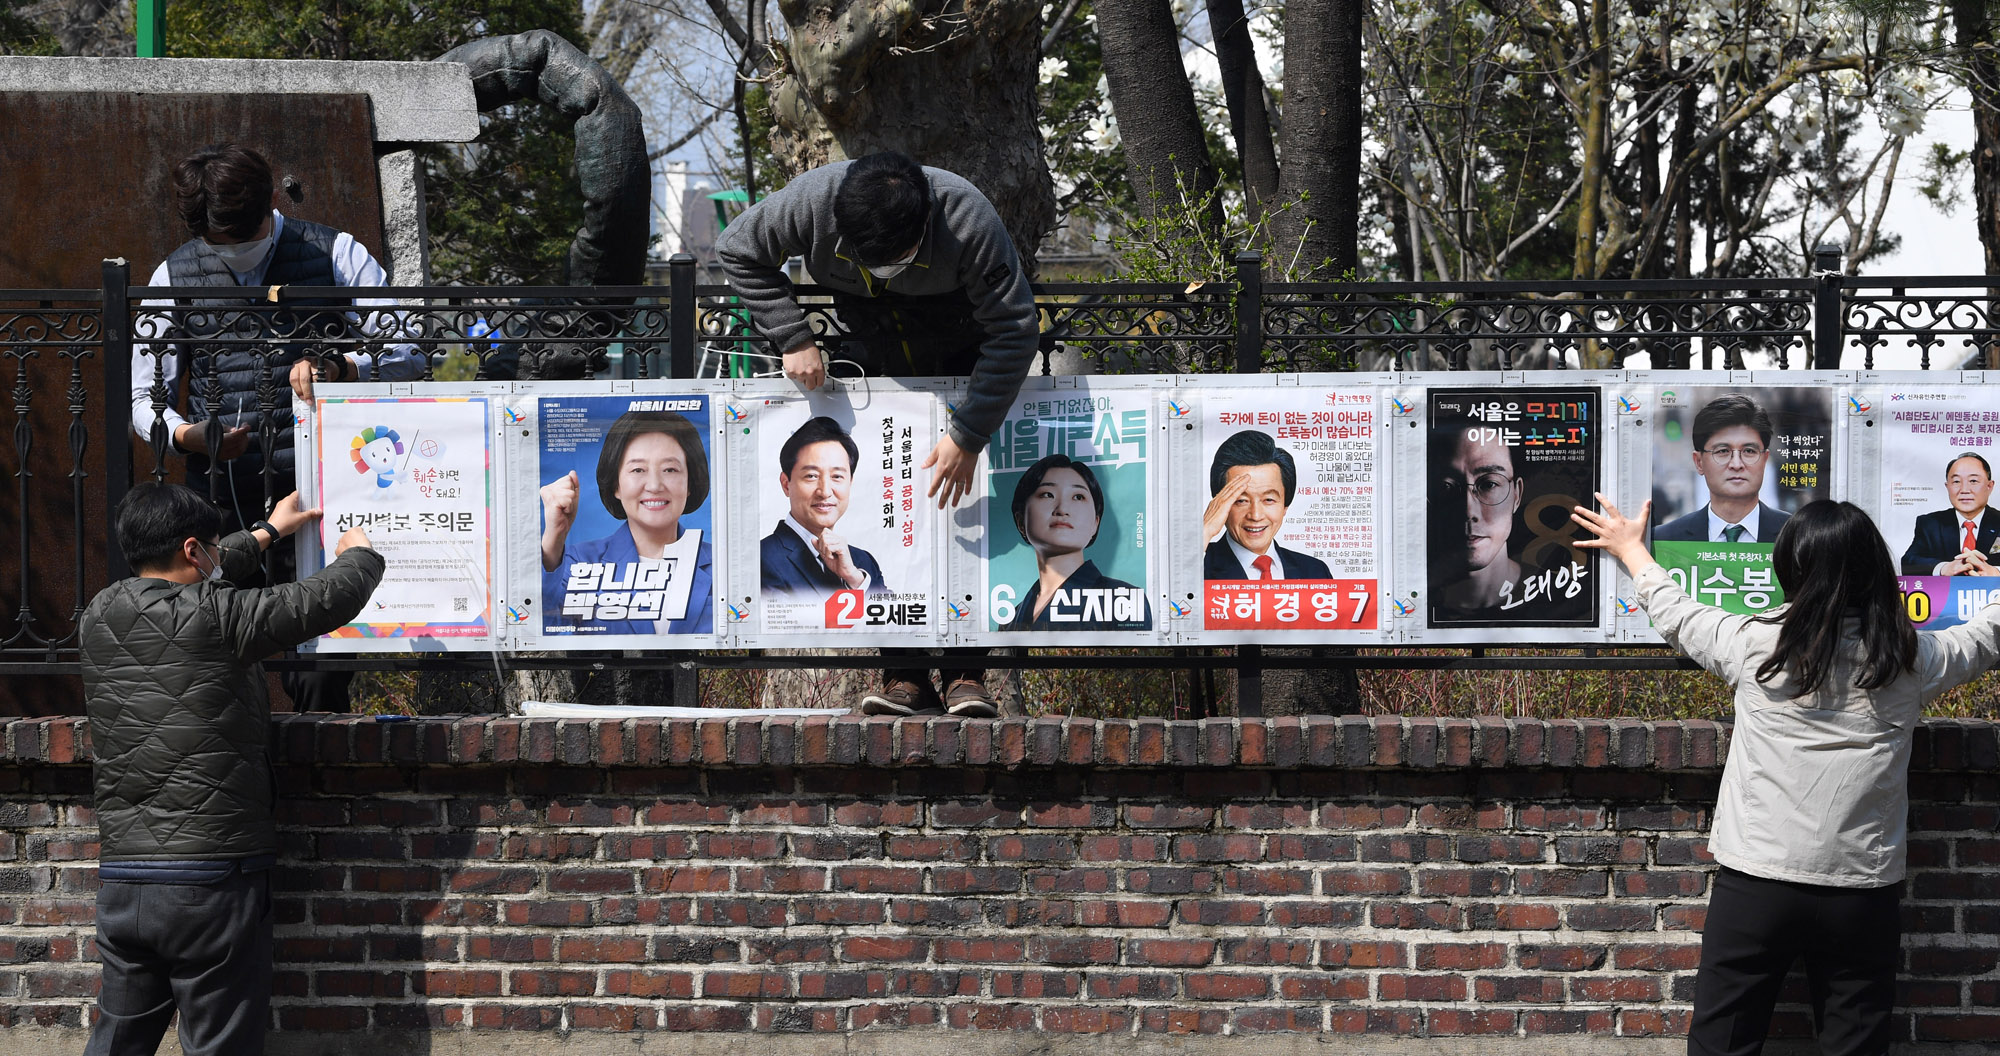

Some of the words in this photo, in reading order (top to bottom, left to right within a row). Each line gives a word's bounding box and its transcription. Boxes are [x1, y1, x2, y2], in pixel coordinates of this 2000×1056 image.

[628, 401, 664, 411] 서울시
[665, 400, 701, 411] 대전환
[1338, 395, 1372, 403] 국가혁명당
[1219, 412, 1253, 425] 국가에
[1257, 411, 1280, 425] 돈이
[1284, 411, 1307, 425] 없는
[1311, 411, 1334, 425] 것이
[1338, 411, 1372, 424] 아니라
[1467, 402, 1522, 421] 서울은
[1525, 401, 1588, 421] 무지개
[1946, 411, 1980, 421] 에덴동산
[1982, 411, 1999, 421] 공원
[1277, 426, 1322, 439] 도둑놈이
[1327, 426, 1372, 439] 많습니다
[1467, 427, 1522, 447] 이기는
[1525, 427, 1588, 446] 소수자
[1911, 424, 1953, 434] 메디컬시티
[1956, 424, 1976, 434] 조성,
[882, 416, 894, 470] 첫날부터
[1292, 441, 1309, 451] 국가
[1311, 441, 1336, 451] 미래를
[1339, 441, 1372, 451] 내다보는
[1950, 436, 1992, 447] 예산효율화
[901, 426, 912, 479] 서울부터
[1309, 452, 1342, 461] 허경영이
[1345, 452, 1372, 461] 옳았다!
[413, 467, 437, 483] 훼손
[439, 470, 459, 481] 하면
[1315, 462, 1324, 472] 그
[1326, 462, 1351, 472] 나물에
[1353, 462, 1362, 472] 그
[1364, 462, 1372, 472] 밥
[1779, 463, 1798, 474] 서민
[1800, 463, 1818, 474] 행복
[1318, 473, 1335, 483] 이제
[1337, 473, 1372, 483] 끝냅시다.
[1779, 476, 1798, 487] 서울
[1799, 476, 1818, 487] 혁명
[420, 485, 433, 498] 안
[436, 487, 461, 498] 돼요!
[1297, 487, 1319, 495] 서울시
[1322, 487, 1337, 495] 예산
[1339, 487, 1354, 495] 70%
[1356, 487, 1372, 495] 절약!
[882, 476, 894, 528] 능숙하게
[336, 512, 411, 533] 선거벽보
[418, 512, 474, 532] 주의문
[901, 485, 913, 547] 공정·상생
[1136, 512, 1144, 548] 기본소득당
[1521, 493, 1588, 575] 8
[1696, 552, 1727, 561] 기본소득
[1728, 552, 1737, 561] 첫
[567, 562, 671, 591] 합니다
[1499, 561, 1589, 610] 오태양
[1898, 580, 1924, 590] 기호
[1667, 565, 1776, 609] 이수봉
[562, 592, 665, 620] 박영선
[868, 593, 926, 601] 서울특별시장후보
[990, 584, 1016, 625] 6
[1050, 587, 1144, 622] 신지혜
[1957, 589, 2000, 622] 배
[837, 592, 857, 626] 2
[865, 603, 927, 626] 오세훈
[1348, 592, 1369, 623] 7
